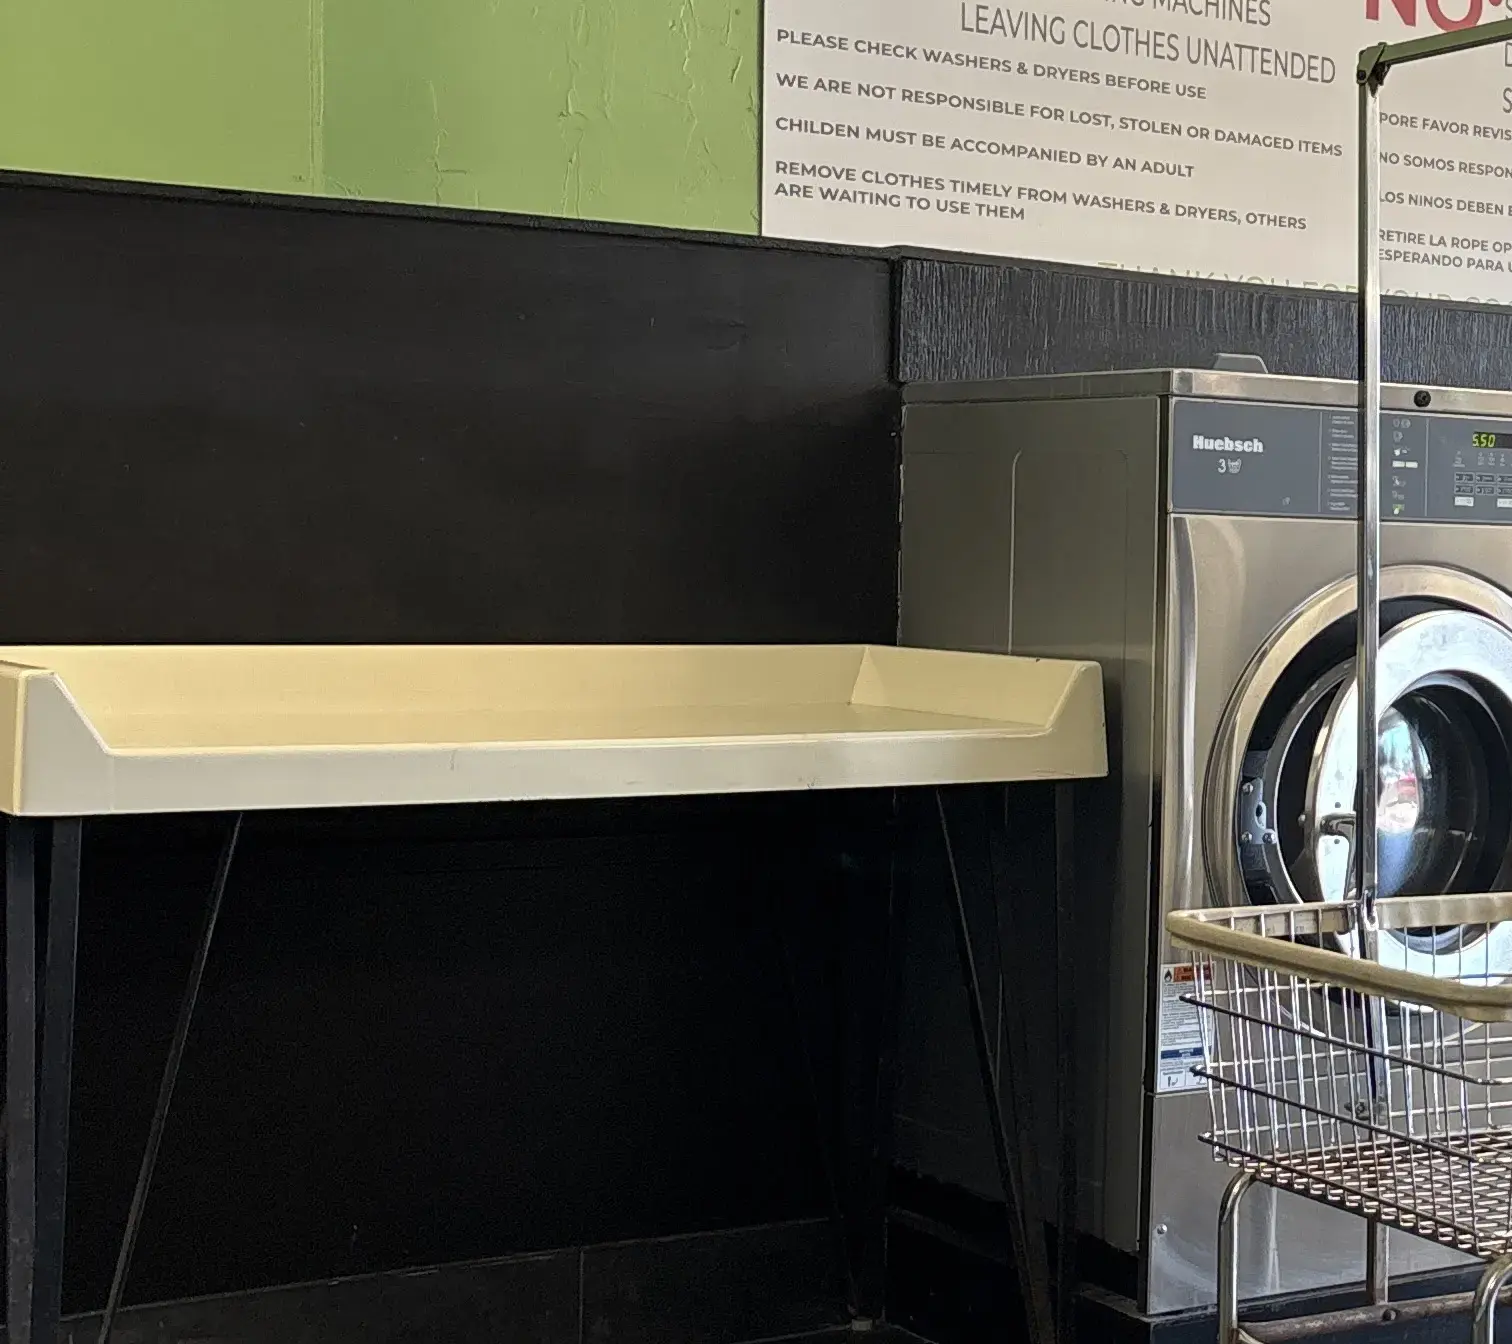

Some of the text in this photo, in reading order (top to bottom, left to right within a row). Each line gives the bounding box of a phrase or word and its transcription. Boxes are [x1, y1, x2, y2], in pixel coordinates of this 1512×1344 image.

[961, 1, 1336, 84] LEAVING CLOTHES UNATTENDED
[776, 28, 1207, 100] PLEASE CHECK WASHERS & DRYERS BEFORE USE
[775, 72, 1343, 157] WE ARE NOT RESPONSIBLE FOR LOST, STOLEN OR DAMAGED ITEMS
[1380, 111, 1419, 129] PORE
[1421, 117, 1470, 136] FAVOR
[775, 116, 1195, 178] CHILDEN MUST BE ACCOMPANIED BY AN ADULT
[1380, 151, 1400, 165] NO
[1403, 153, 1456, 172] SOMOS
[773, 182, 1025, 221] ARE WAITING TO USE THEM
[775, 160, 1307, 230] REMOVE CLOTHES TIMELY FROM WASHERS & DRYERS, OTHERS
[1408, 193, 1454, 210] NINOS
[1456, 199, 1504, 216] DEBEN
[1379, 228, 1426, 246] RETIRE
[1429, 233, 1448, 248] LA
[1450, 236, 1489, 252] ROPE
[1379, 248, 1463, 268] ESPERANDO
[1466, 257, 1505, 273] PARA
[1192, 435, 1264, 454] Huebsch
[1217, 458, 1227, 474] 3
